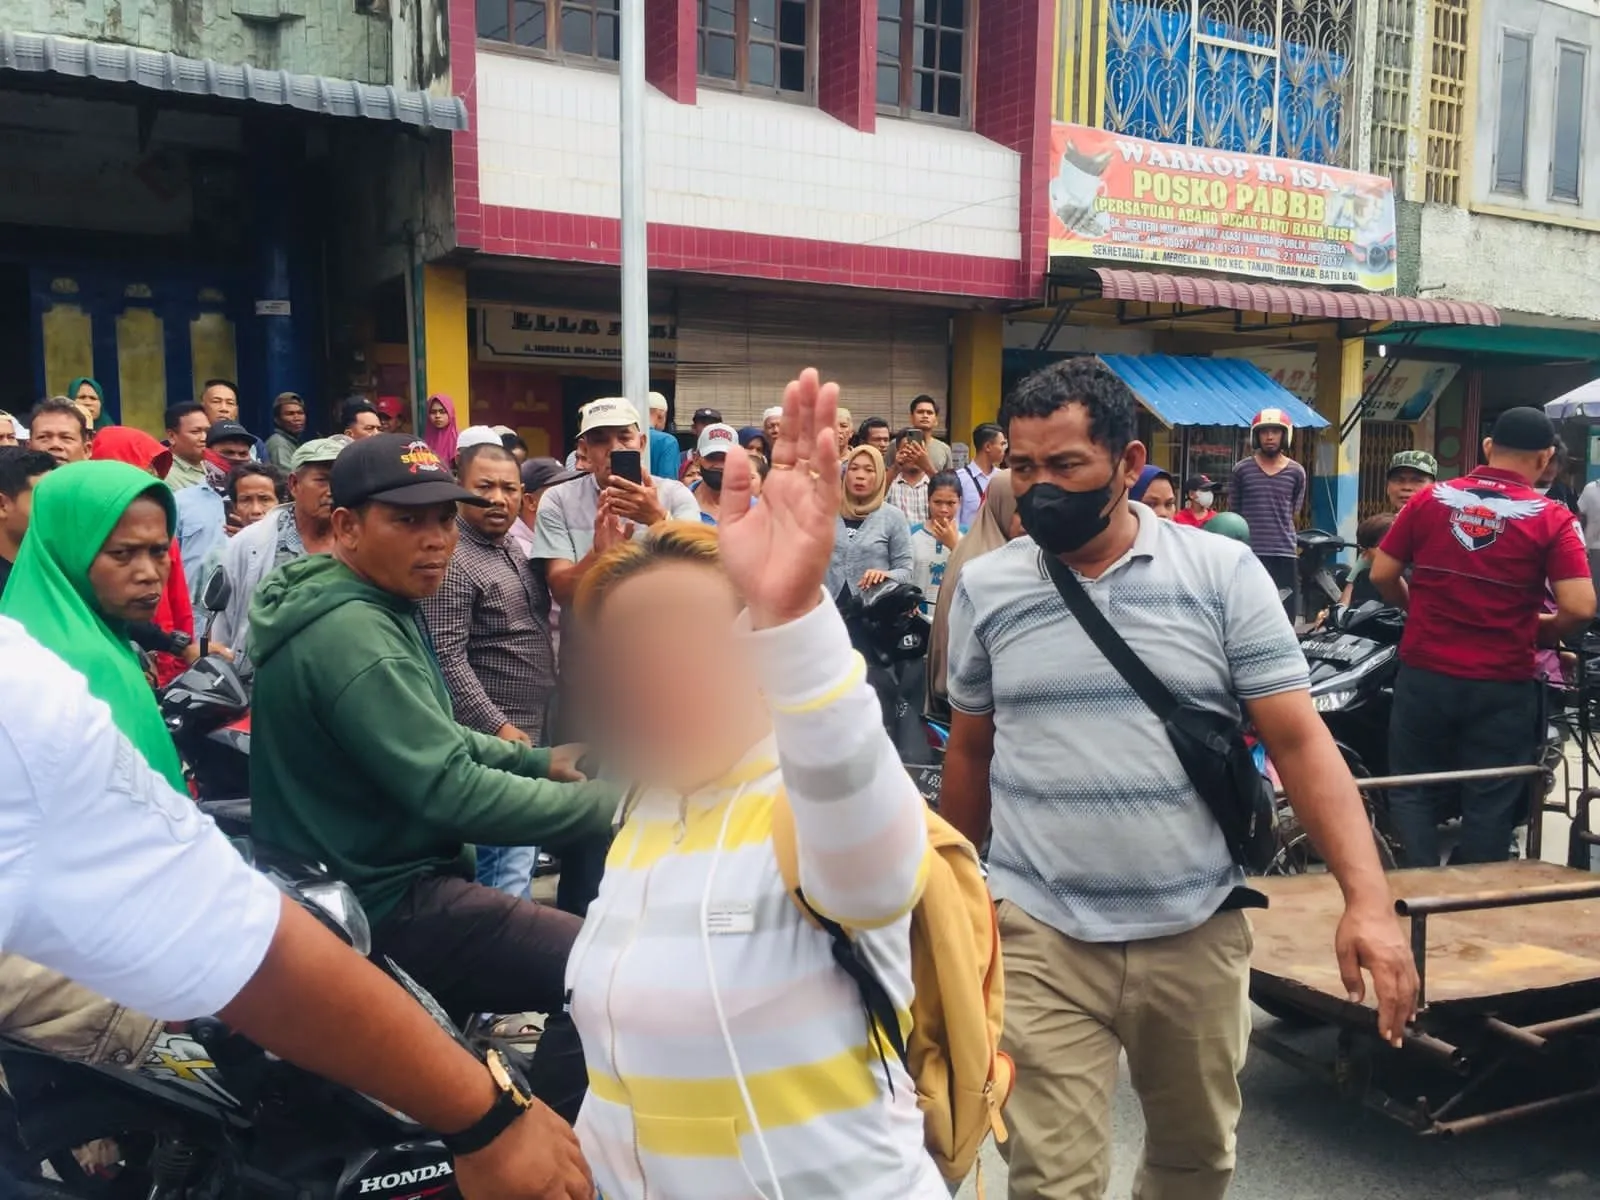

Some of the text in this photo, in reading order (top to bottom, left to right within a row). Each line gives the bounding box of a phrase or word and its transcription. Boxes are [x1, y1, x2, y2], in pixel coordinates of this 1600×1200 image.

[1114, 140, 1249, 178] WARKOP
[1290, 166, 1339, 191] ISA
[1133, 169, 1325, 221] POSKO PABBB
[1094, 197, 1175, 220] (PERSATUAN
[1292, 221, 1324, 238] BARA
[511, 310, 600, 335] ELLA
[359, 1161, 453, 1193] HONDA
